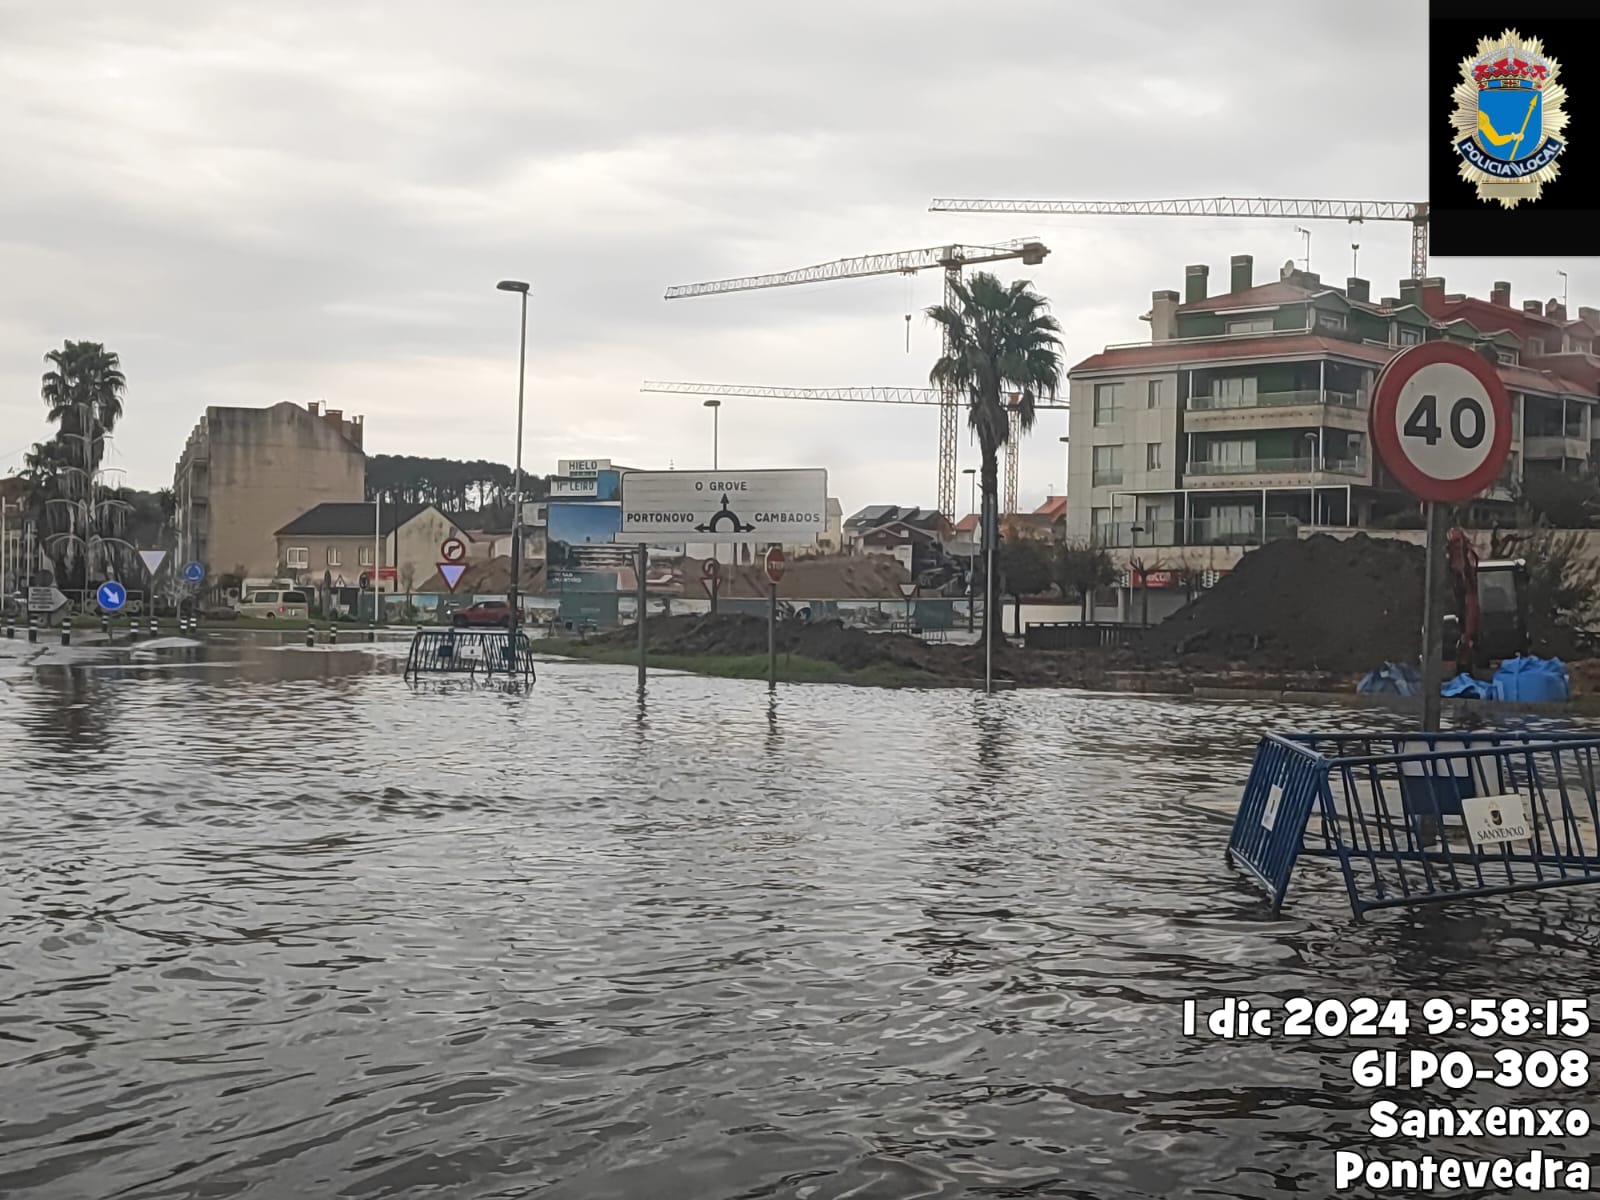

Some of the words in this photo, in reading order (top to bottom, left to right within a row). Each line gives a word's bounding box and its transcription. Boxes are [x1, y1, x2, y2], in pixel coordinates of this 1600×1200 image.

[1403, 394, 1487, 449] 40
[695, 481, 703, 491] O
[709, 481, 748, 491] GROVE
[626, 512, 694, 523] PORTONOVO
[754, 512, 820, 523] CAMBADOS
[1476, 825, 1525, 841] SANXENXO
